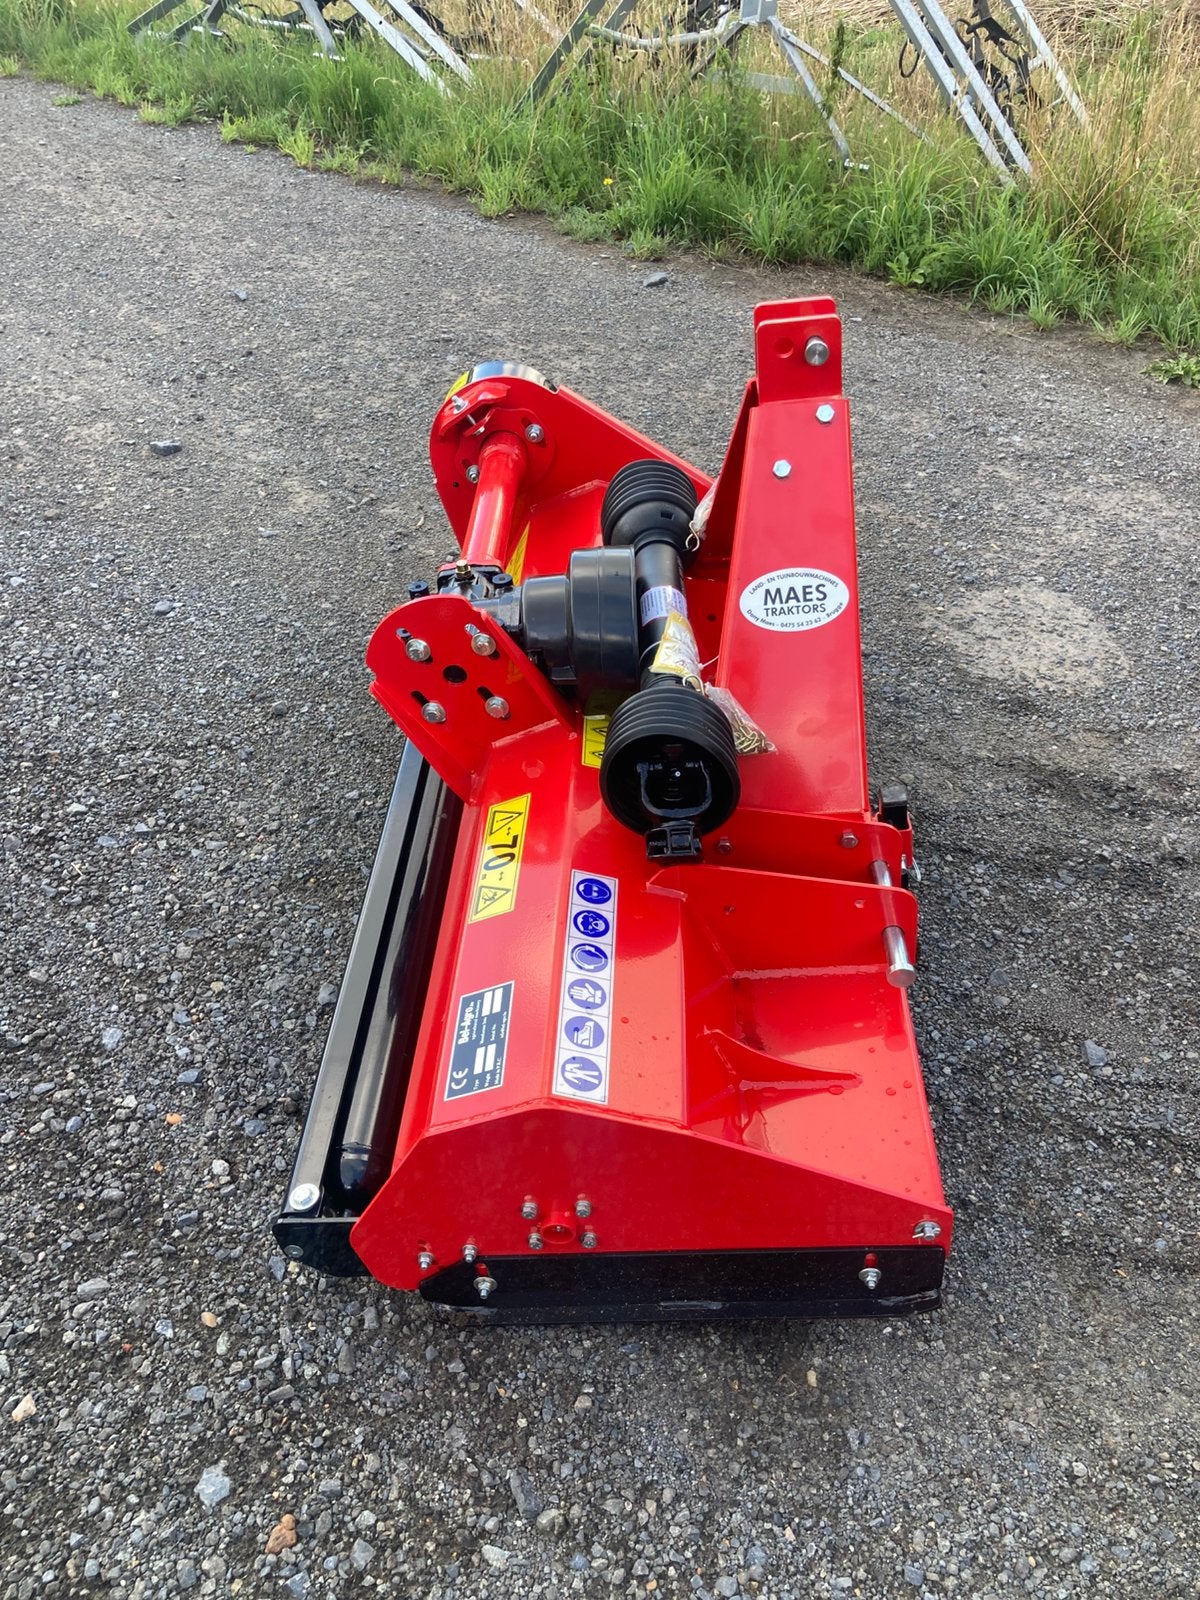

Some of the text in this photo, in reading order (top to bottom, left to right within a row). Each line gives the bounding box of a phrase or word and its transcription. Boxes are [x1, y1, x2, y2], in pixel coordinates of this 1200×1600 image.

[749, 572, 839, 595] LAND- EN TUINBOUWMACHINES
[763, 583, 828, 606] MAES
[763, 603, 827, 618] TRAKTORS
[483, 834, 519, 871] 70
